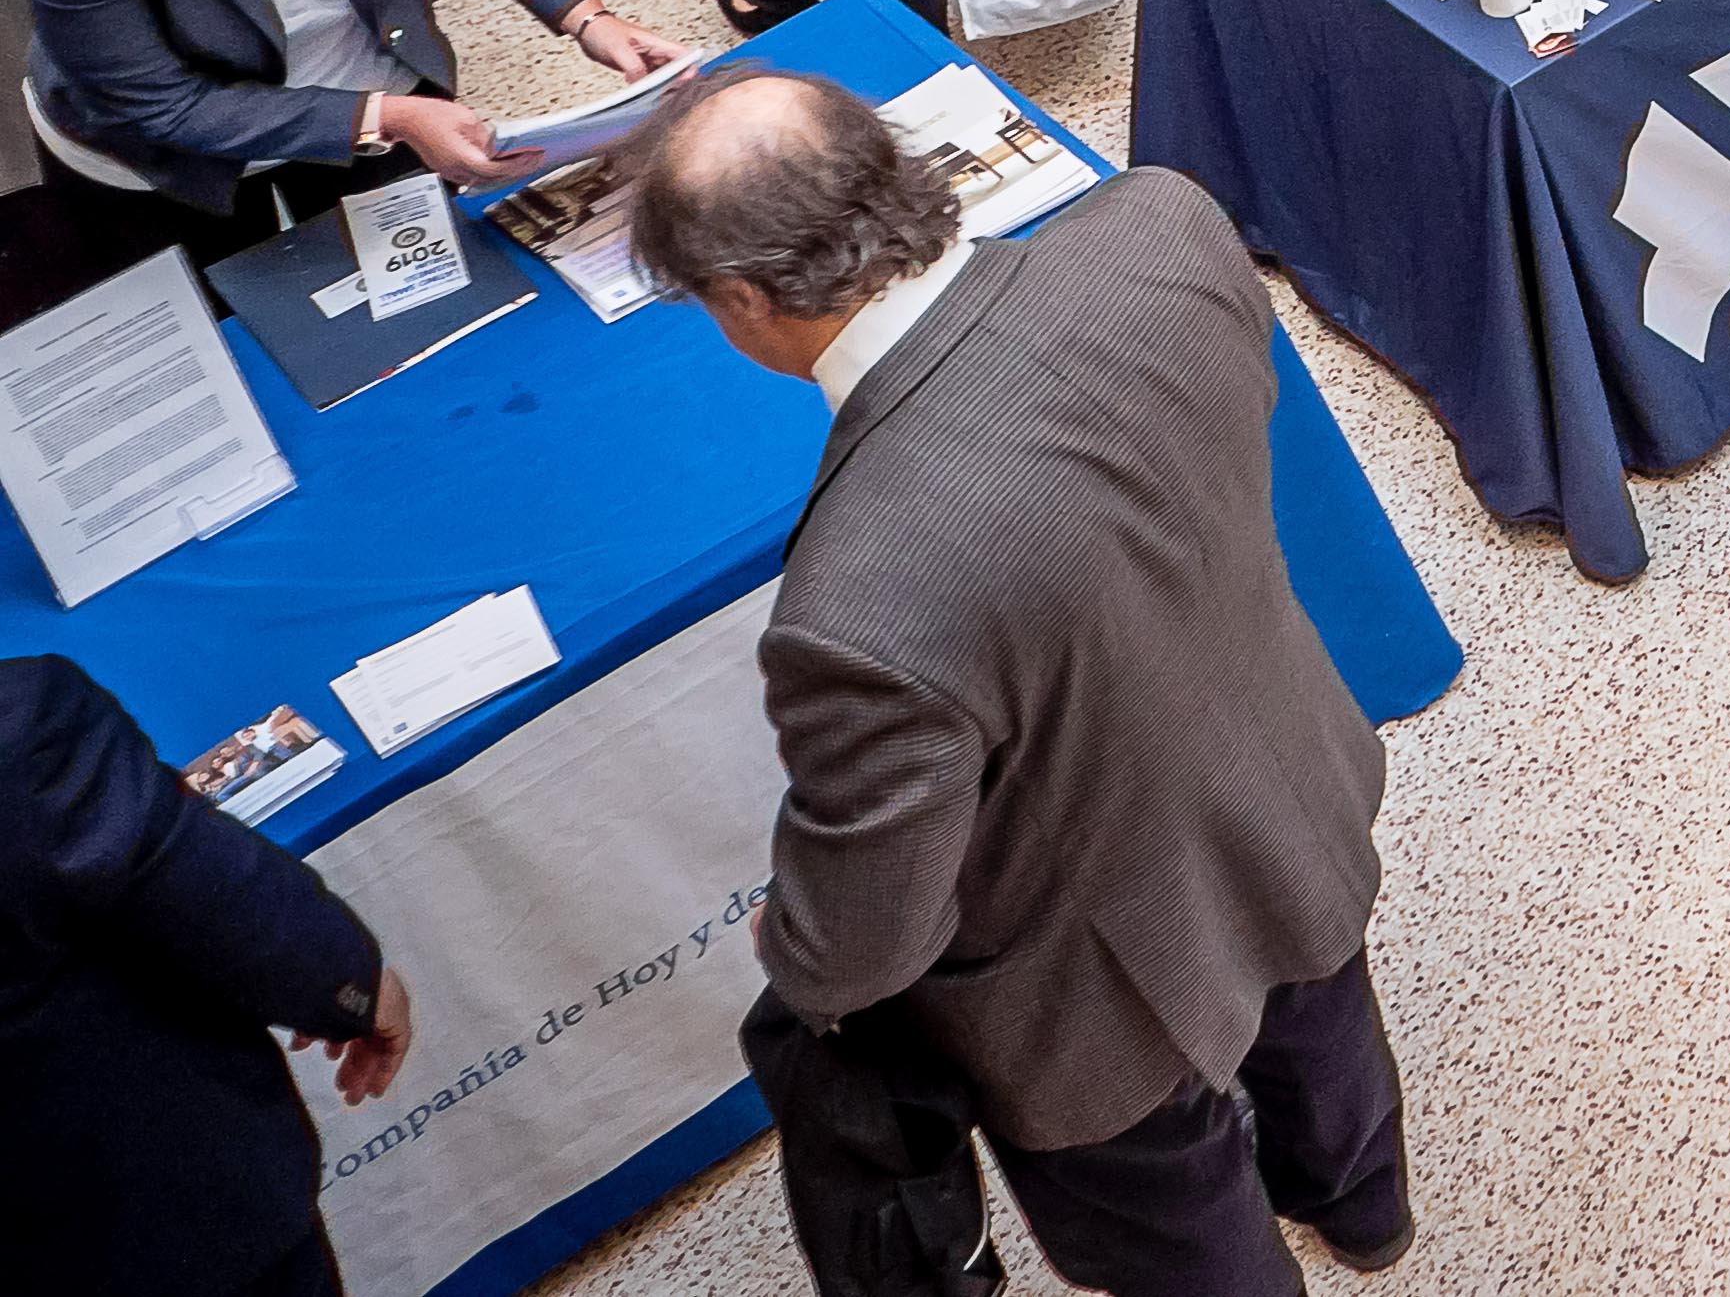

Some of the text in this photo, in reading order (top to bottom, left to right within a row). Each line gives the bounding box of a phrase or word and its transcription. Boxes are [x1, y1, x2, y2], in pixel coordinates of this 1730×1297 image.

[384, 238, 449, 272] 2019
[535, 1001, 586, 1047] de
[592, 943, 681, 1009] Hoy
[688, 920, 713, 959] y
